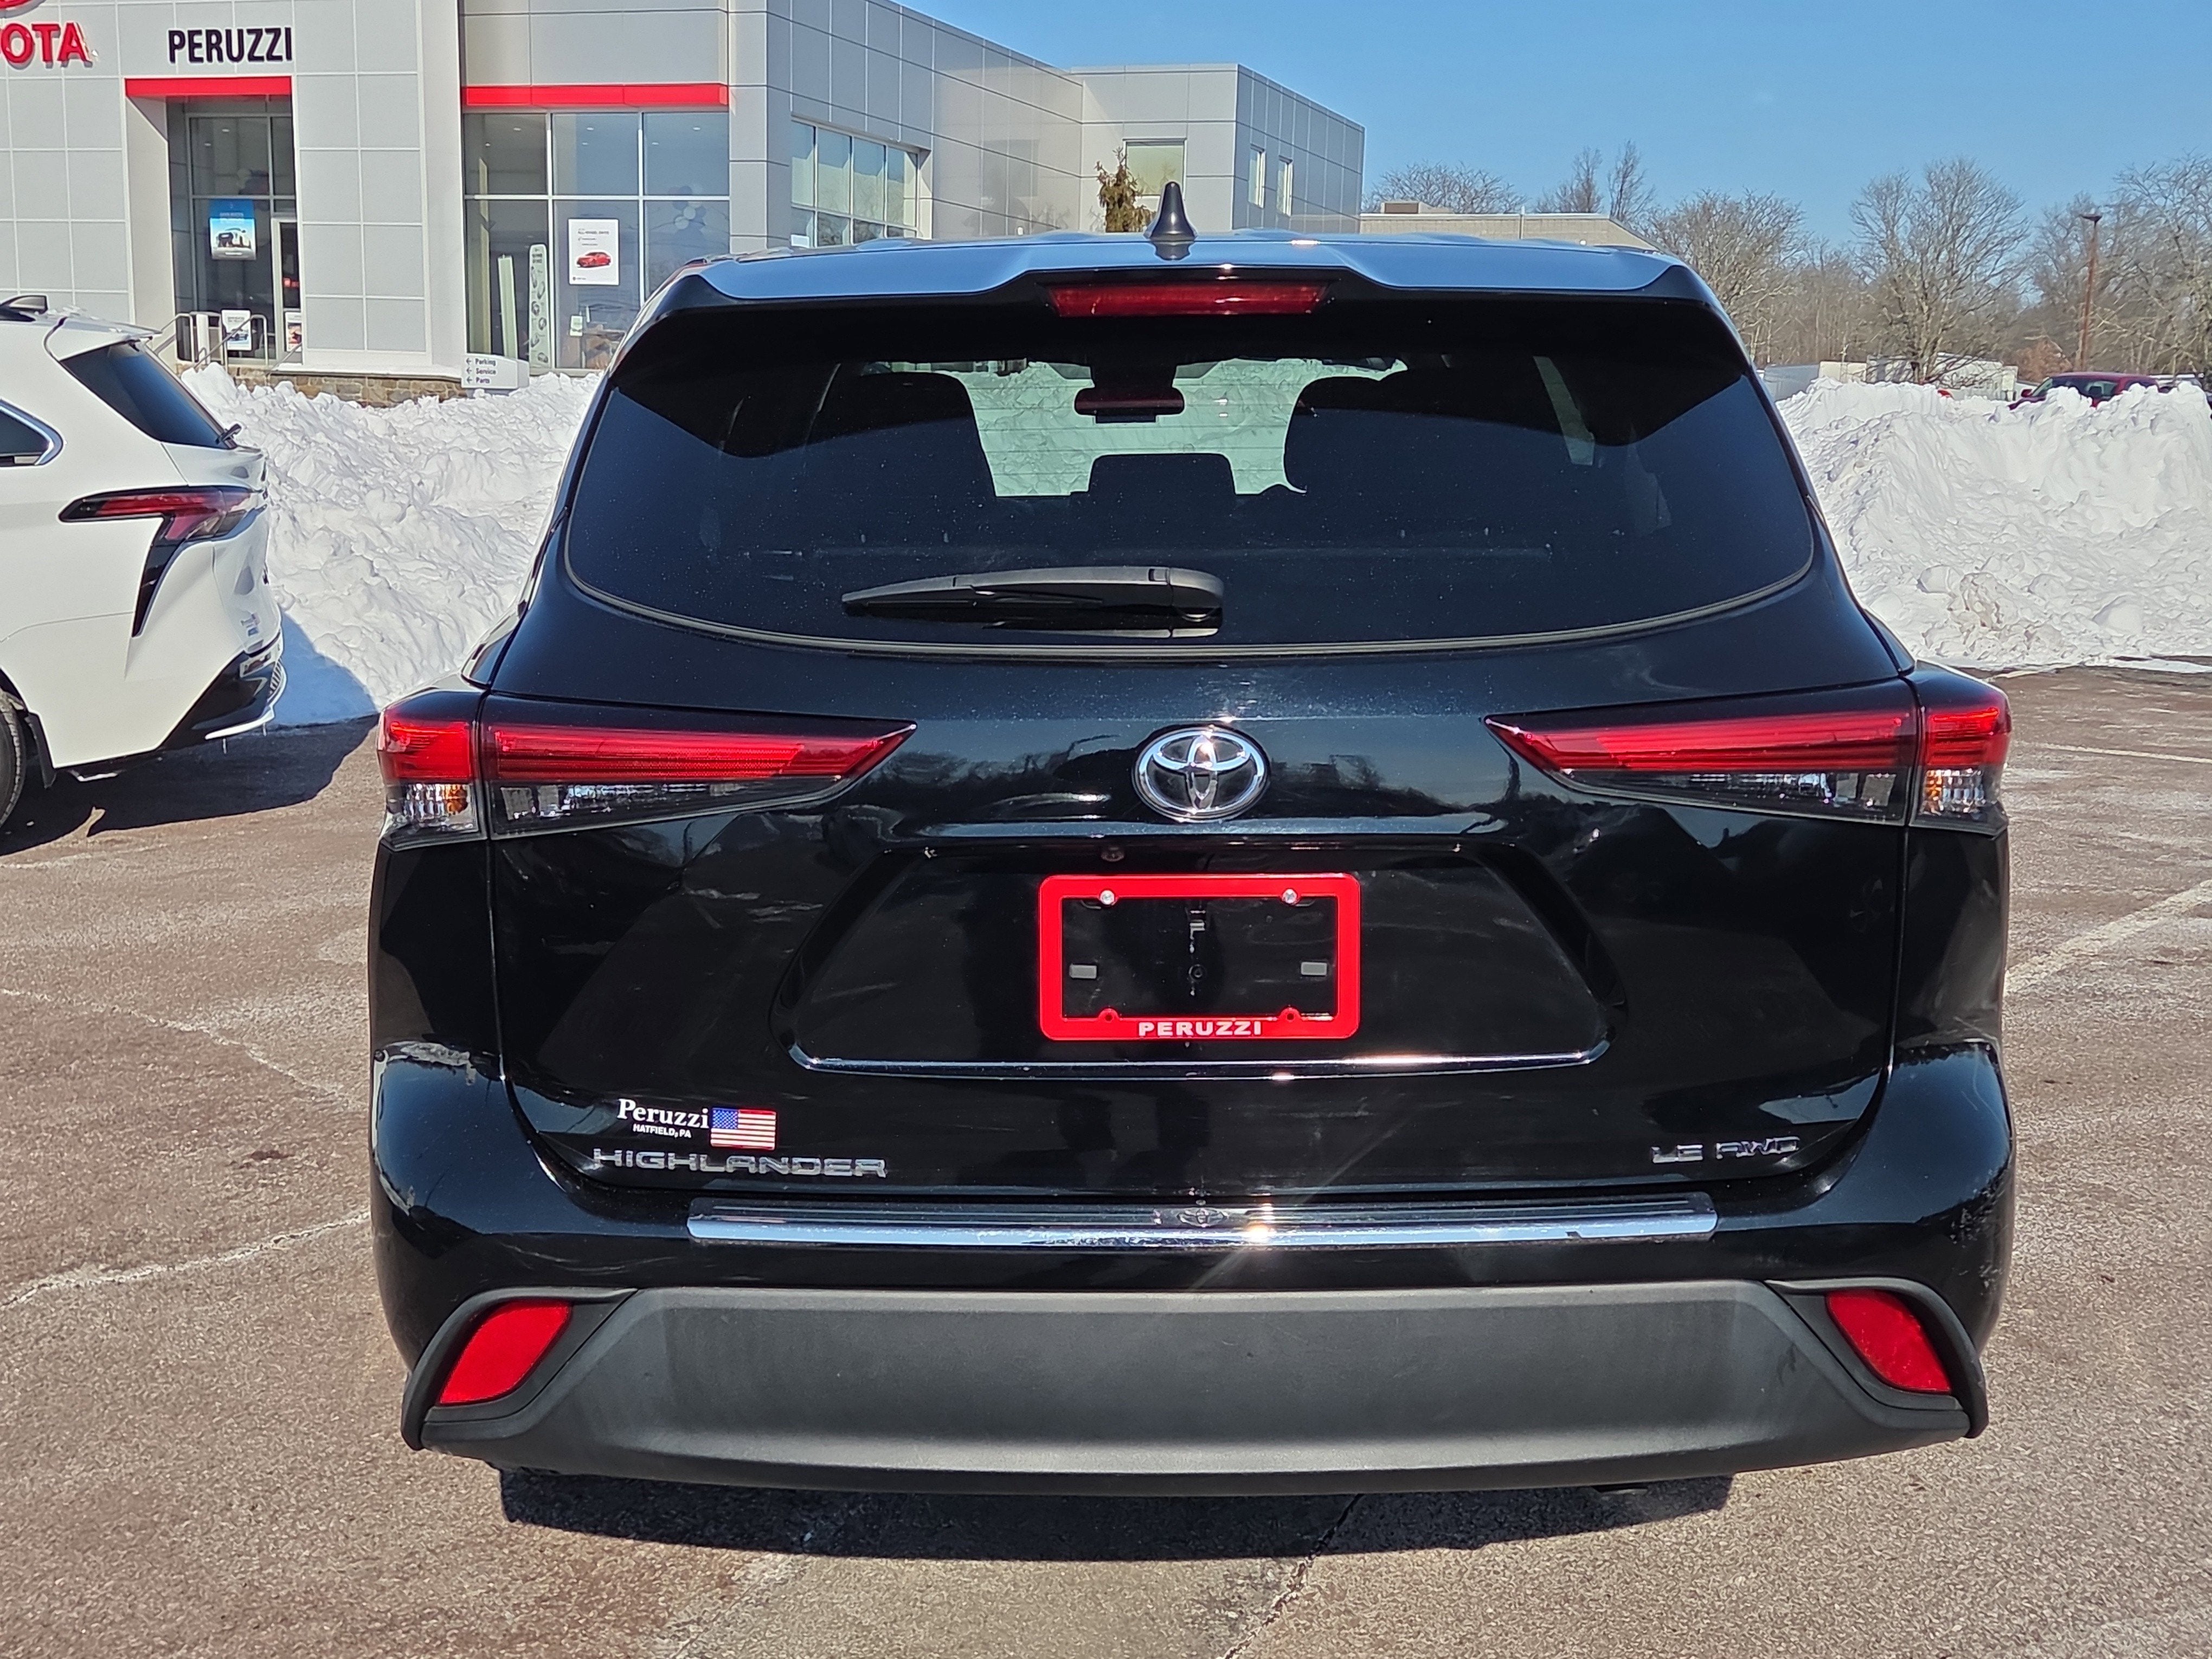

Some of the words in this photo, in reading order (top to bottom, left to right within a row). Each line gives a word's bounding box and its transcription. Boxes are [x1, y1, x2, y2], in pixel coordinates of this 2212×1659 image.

[0, 22, 90, 66] OTA
[168, 27, 292, 63] PERUZZI
[475, 358, 496, 366] Parking
[1138, 1021, 1262, 1037] PERUZZI
[616, 1098, 710, 1129] Peruzzi
[632, 1123, 678, 1138] HATFIELD,
[679, 1129, 692, 1139] PA
[593, 1148, 886, 1179] HIGHLANDER
[1651, 1144, 1703, 1164] LE
